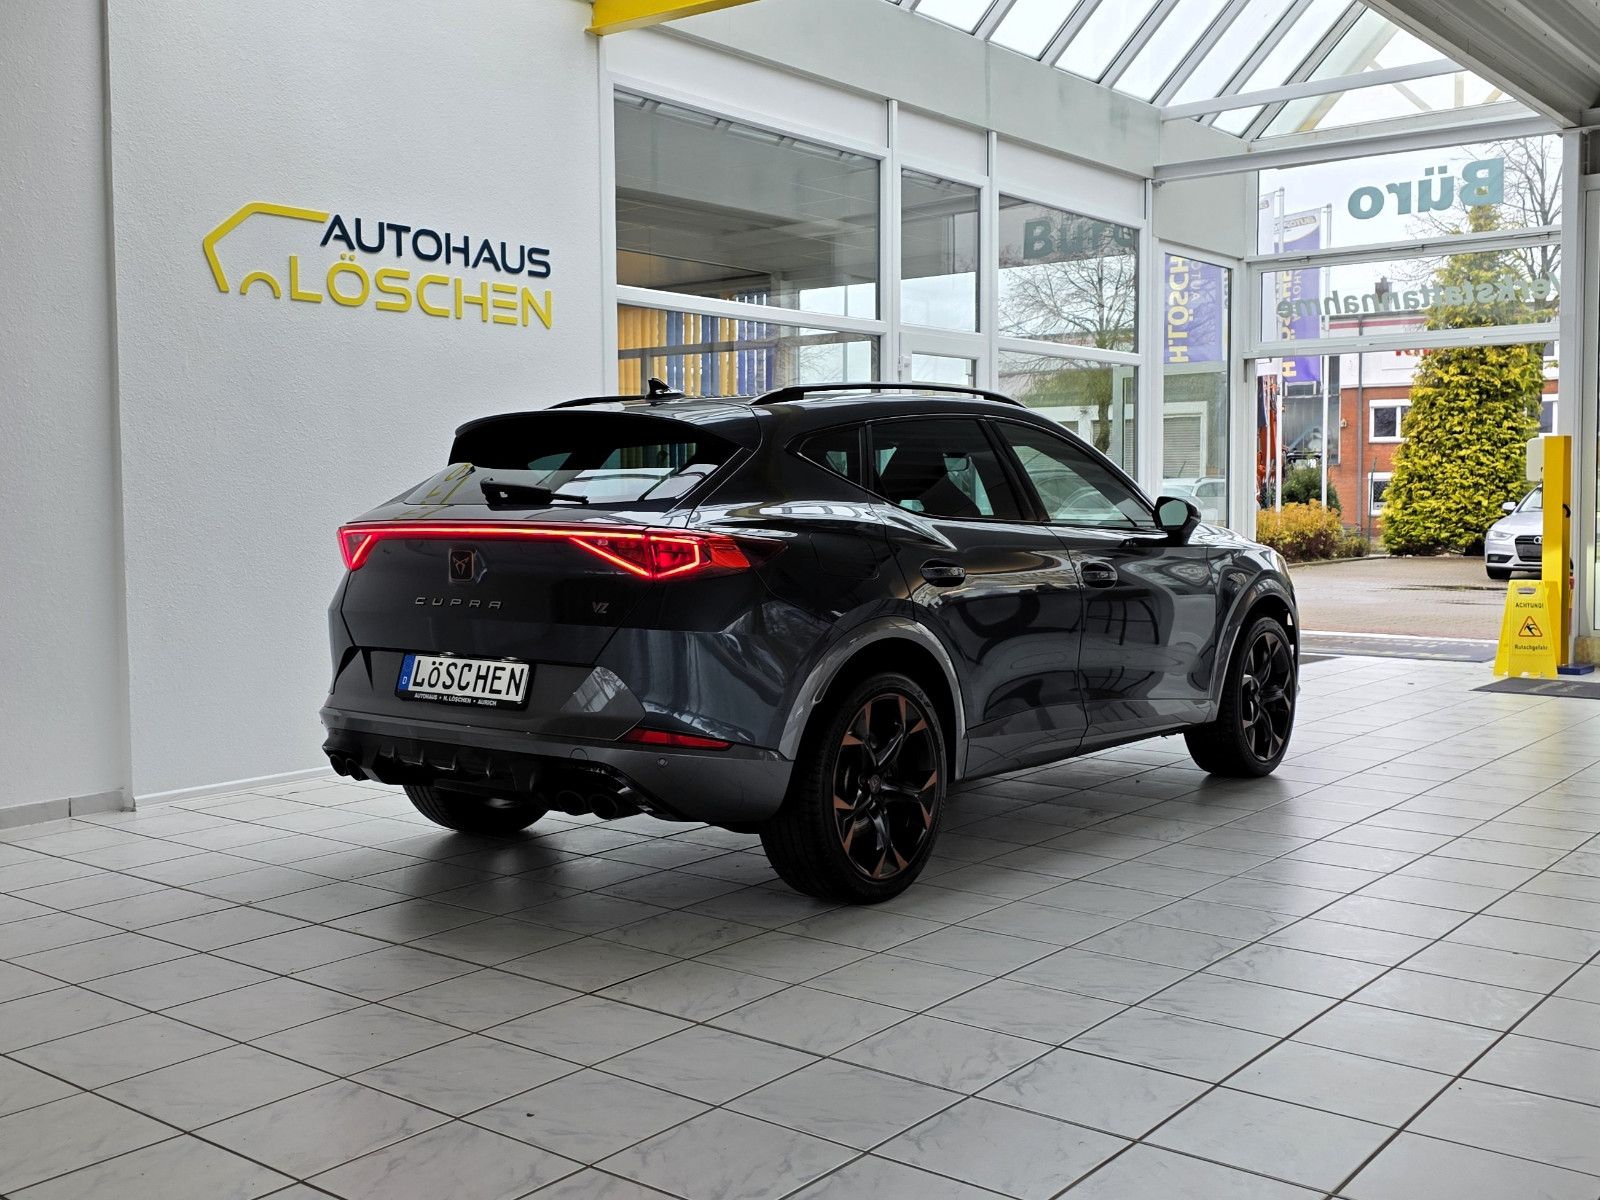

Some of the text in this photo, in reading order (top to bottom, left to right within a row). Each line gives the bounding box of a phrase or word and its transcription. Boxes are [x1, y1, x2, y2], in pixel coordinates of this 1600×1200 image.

[320, 214, 551, 278] AUTOHAUS
[289, 253, 552, 329] LÖSCHEN
[415, 597, 504, 610] CUPRA
[592, 602, 610, 614] VZ
[412, 659, 526, 697] LÖSCHEN
[414, 692, 438, 701] AUTOHAUS
[477, 699, 498, 707] AURICH
